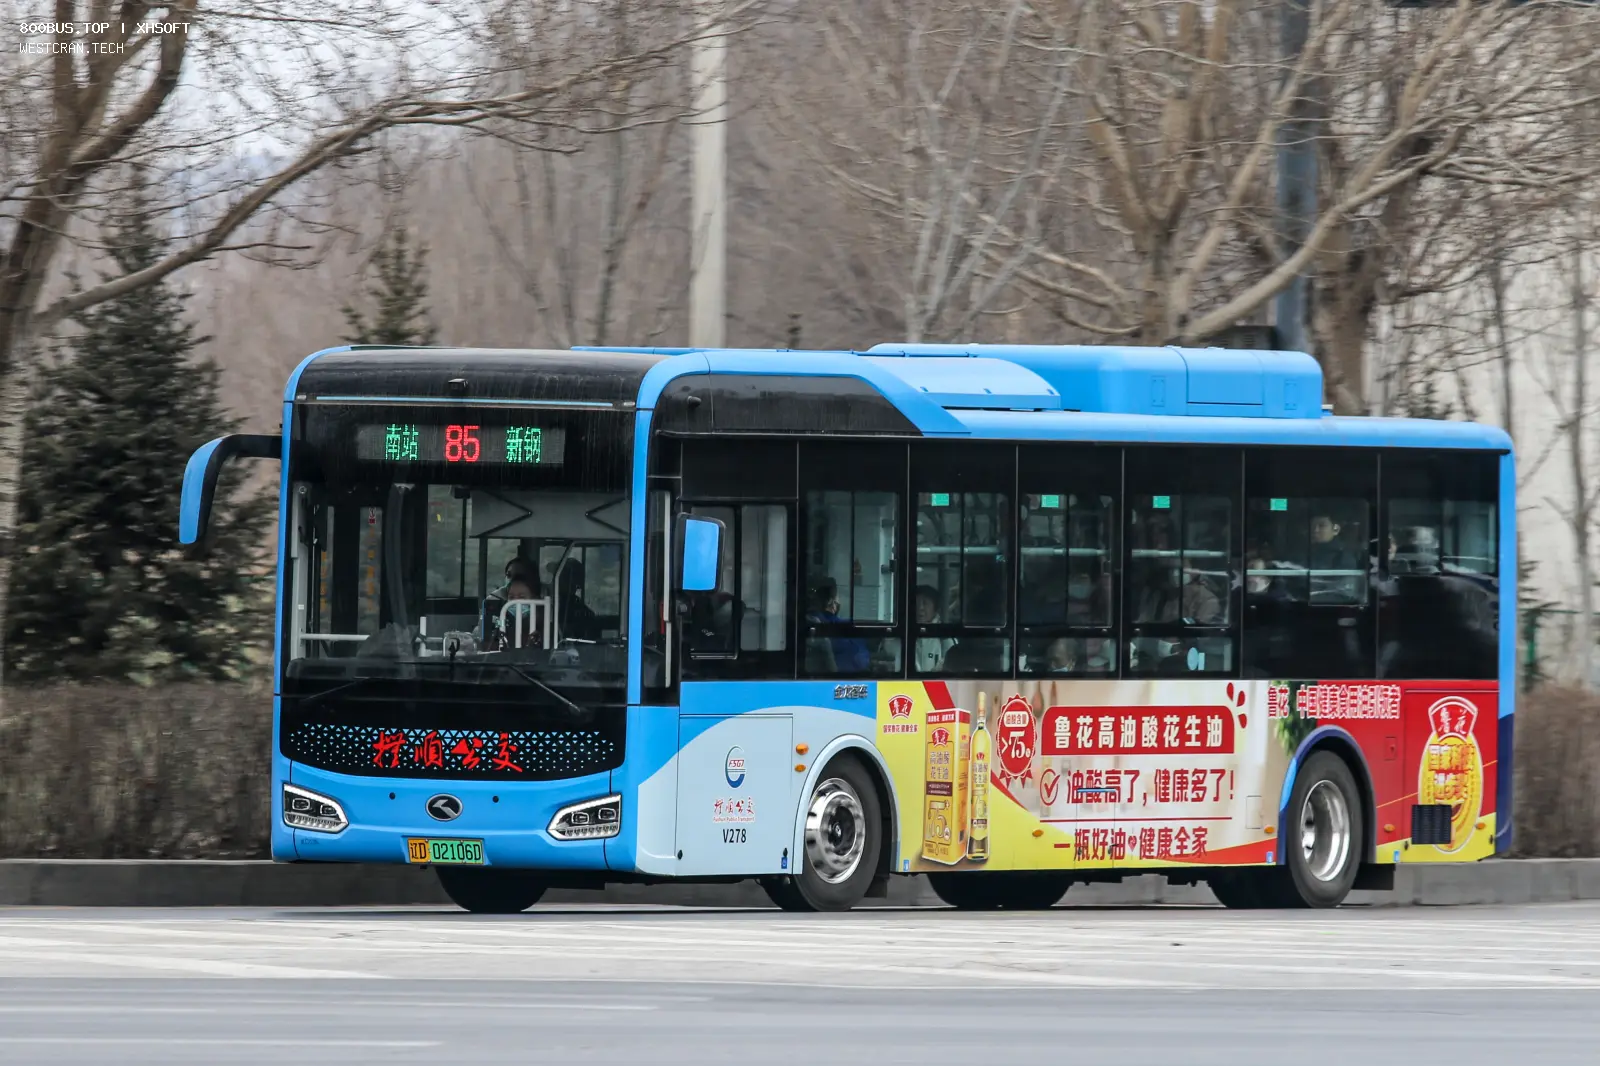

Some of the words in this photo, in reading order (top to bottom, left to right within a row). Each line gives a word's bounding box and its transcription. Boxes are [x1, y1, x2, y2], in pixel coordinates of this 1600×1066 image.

[385, 424, 419, 461] 南站
[445, 425, 480, 462] 85
[506, 426, 541, 463] 新钢
[1267, 685, 1289, 719] 鲁花
[1054, 714, 1223, 749] 鲁花高油酸花生油
[1438, 707, 1468, 735] 鲁花
[432, 842, 481, 861] 02106D
[722, 828, 747, 844] V278
[1054, 828, 1126, 862] 一瓶好油
[1139, 826, 1208, 860] 健康全家
